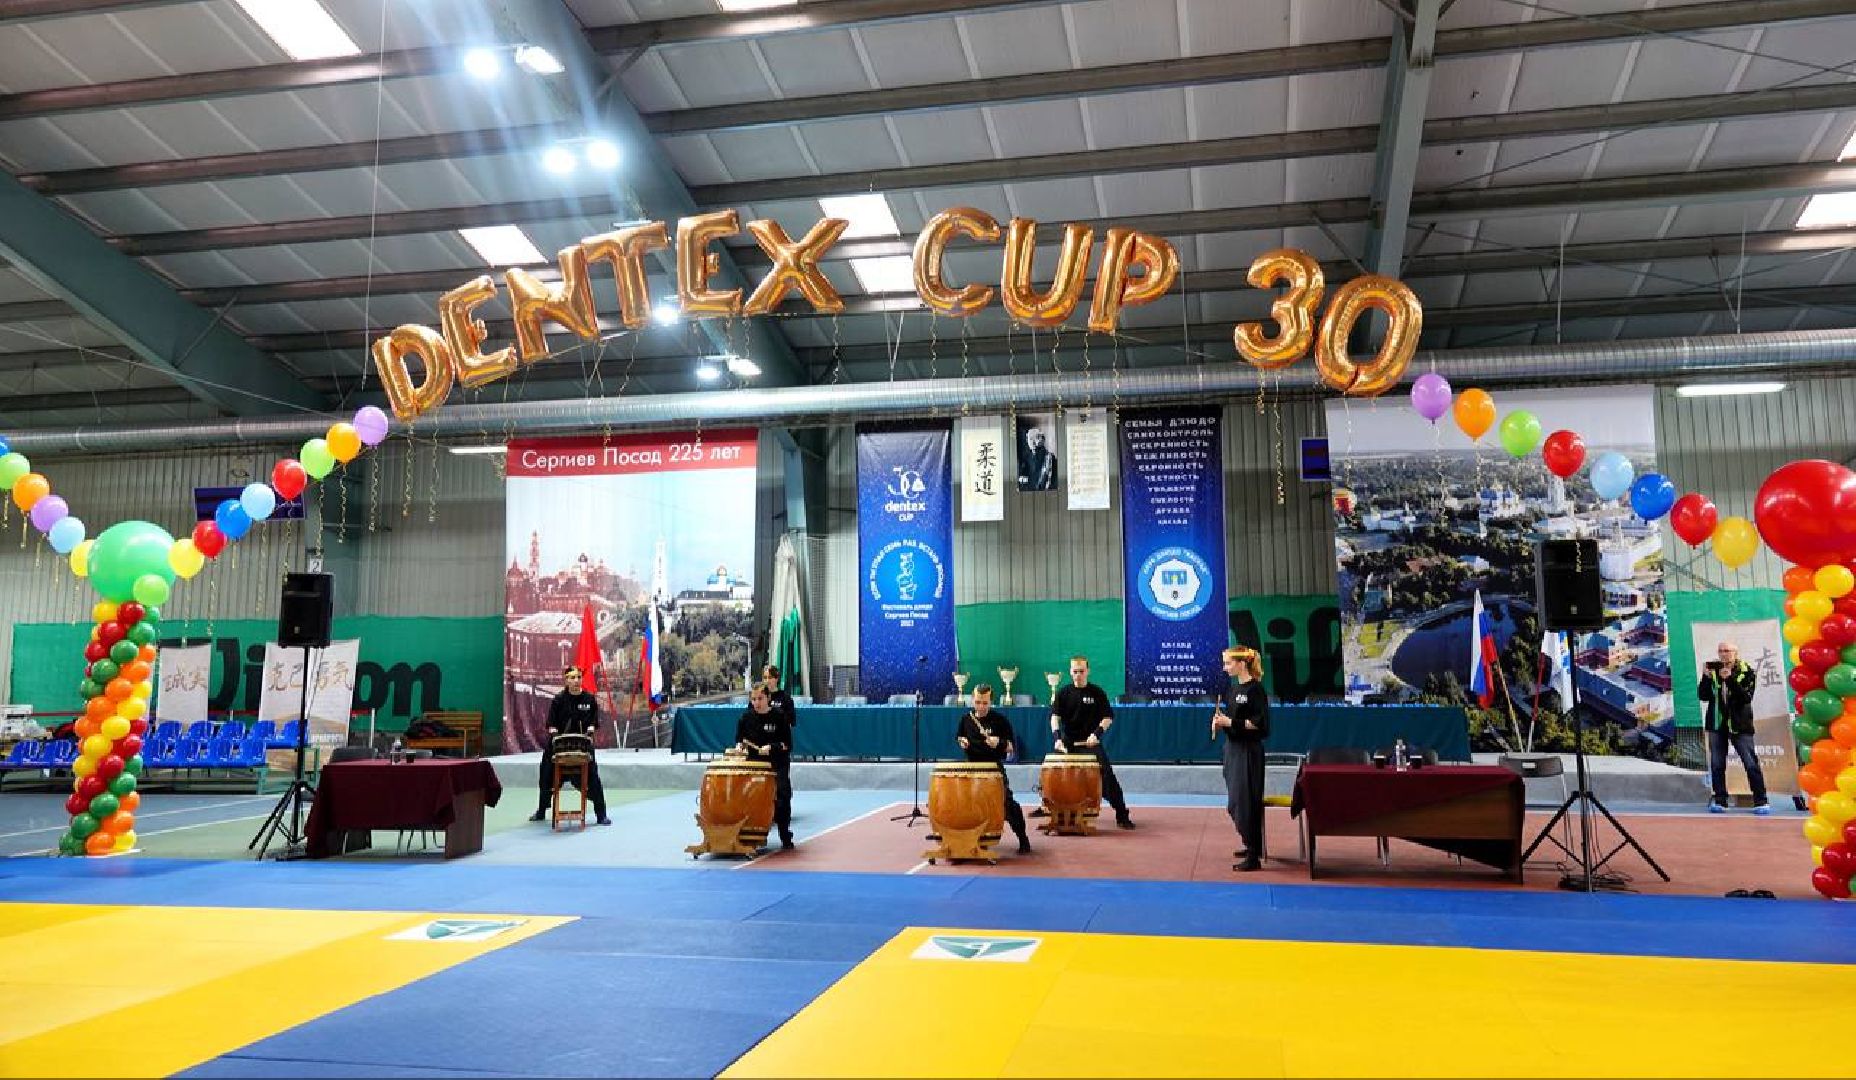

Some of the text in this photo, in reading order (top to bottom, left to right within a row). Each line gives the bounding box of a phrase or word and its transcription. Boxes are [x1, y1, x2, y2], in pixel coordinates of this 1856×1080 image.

[371, 206, 1423, 422] DENTEX CUP 30
[1127, 429, 1214, 439] САМОКОНТРОЛЬ
[522, 443, 741, 471] Сергиев Посад 225 лет
[975, 442, 997, 496] 柔道
[884, 500, 926, 511] dentex
